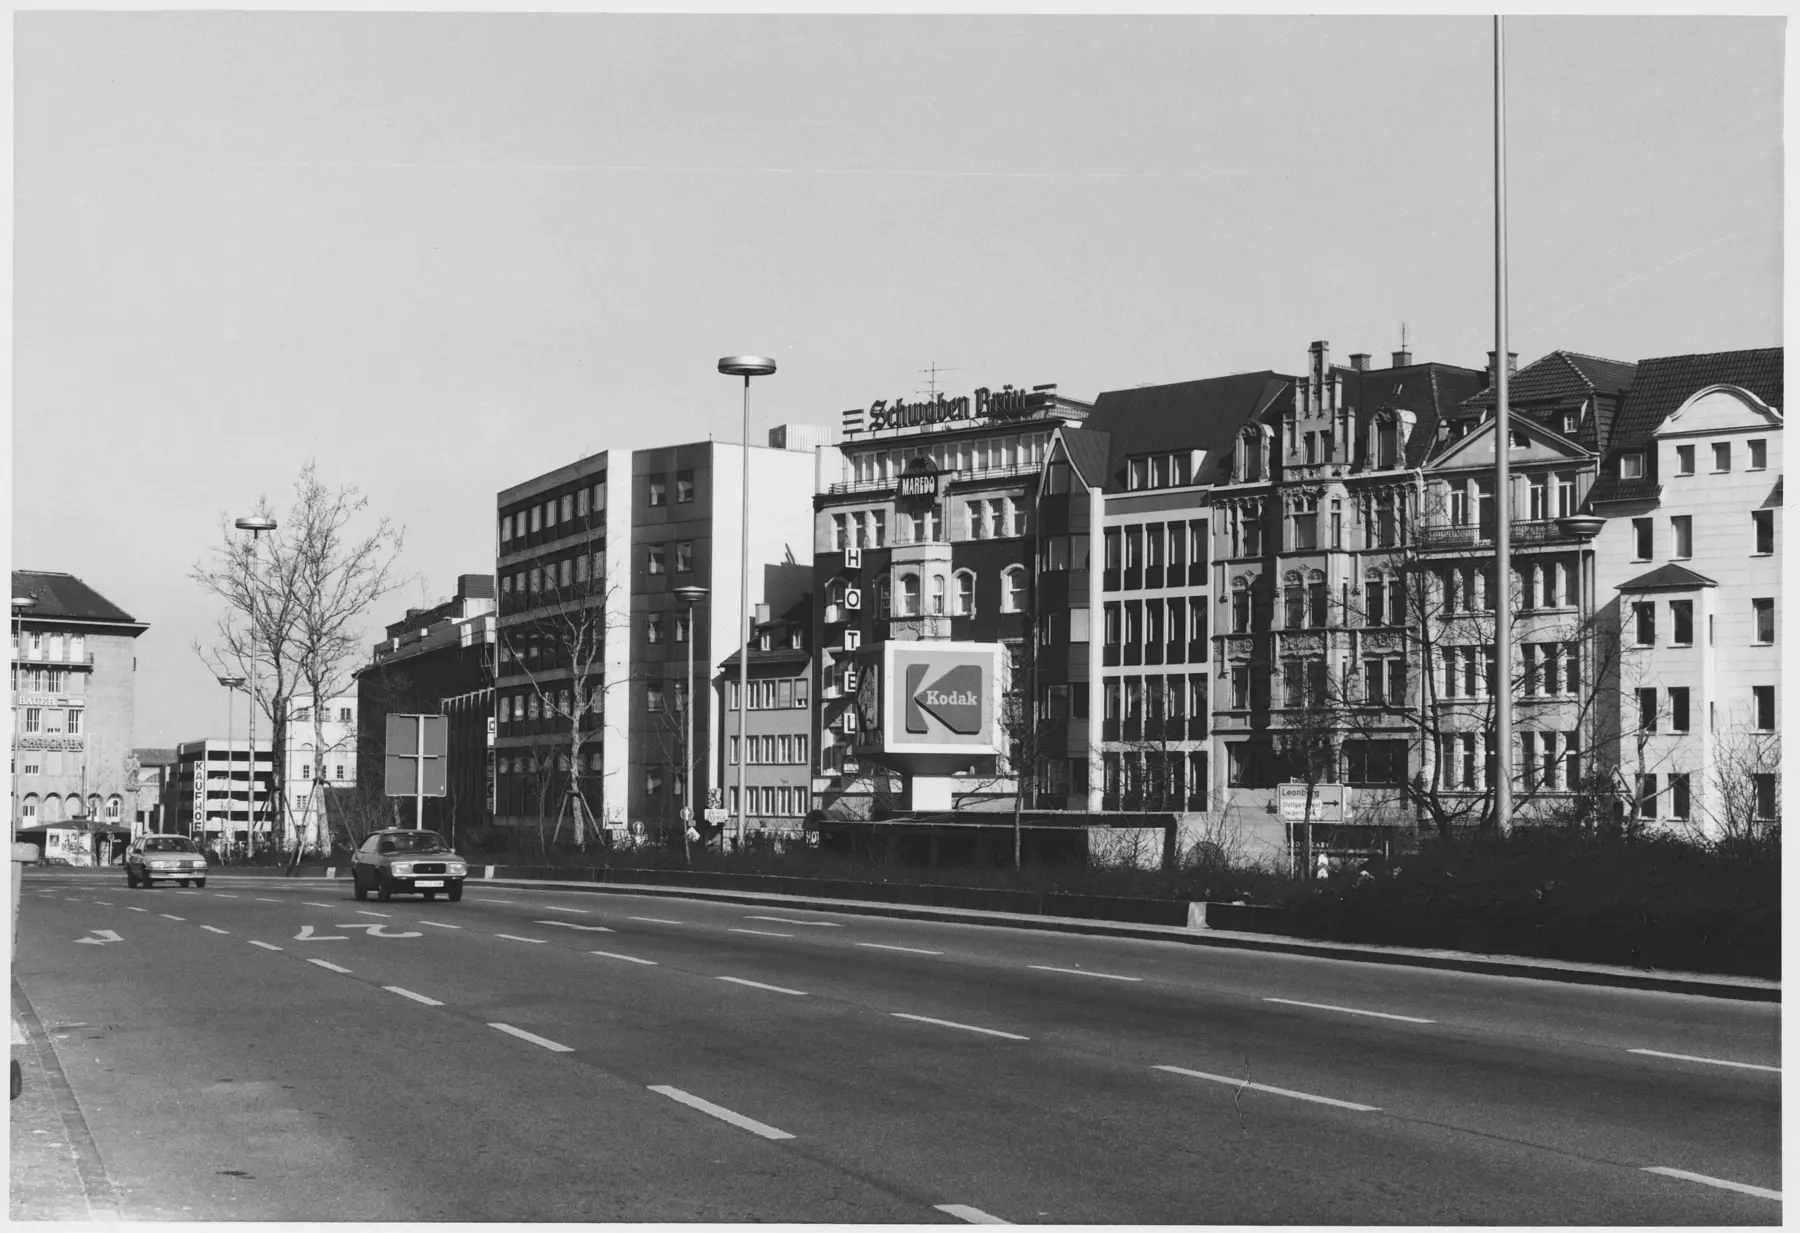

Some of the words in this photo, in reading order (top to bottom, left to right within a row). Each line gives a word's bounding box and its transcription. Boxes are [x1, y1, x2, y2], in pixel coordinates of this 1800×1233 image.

[869, 392, 970, 431] Schwaben
[974, 384, 1027, 418] Bräu
[902, 475, 935, 496] MAREDO
[846, 549, 860, 733] HOTEL
[925, 690, 978, 706] Kodak
[194, 761, 203, 831] KAUFHOF
[1282, 788, 1320, 798] Leonbrg
